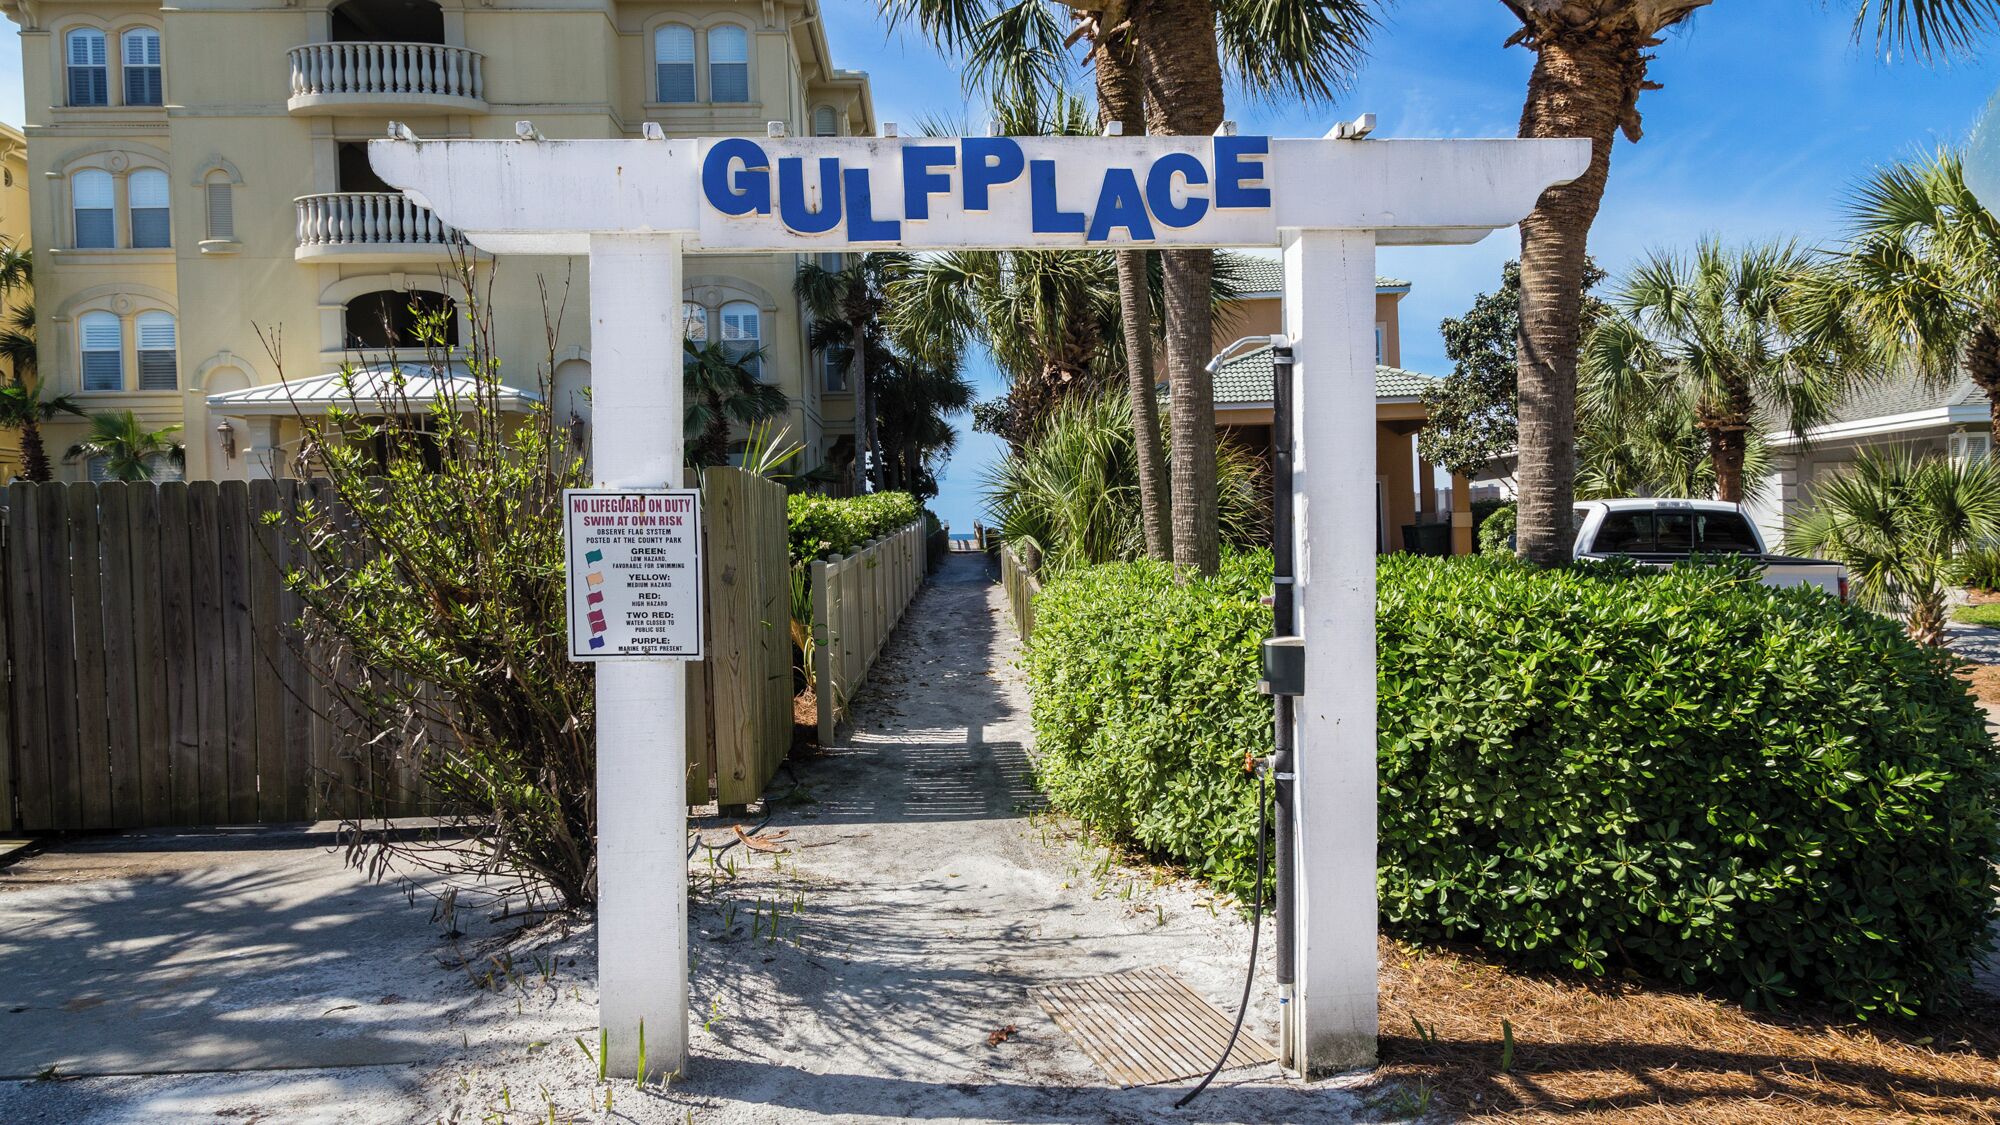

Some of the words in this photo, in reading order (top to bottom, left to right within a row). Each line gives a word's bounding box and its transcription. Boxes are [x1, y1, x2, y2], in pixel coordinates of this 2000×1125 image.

[574, 499, 588, 513] NO
[592, 499, 645, 513] LIFEGUARD
[649, 499, 662, 513] ON
[665, 499, 691, 513] DUTY
[584, 516, 614, 526] SWIM
[618, 516, 628, 526] AT
[632, 516, 656, 526] OWN
[659, 516, 682, 526] RISK
